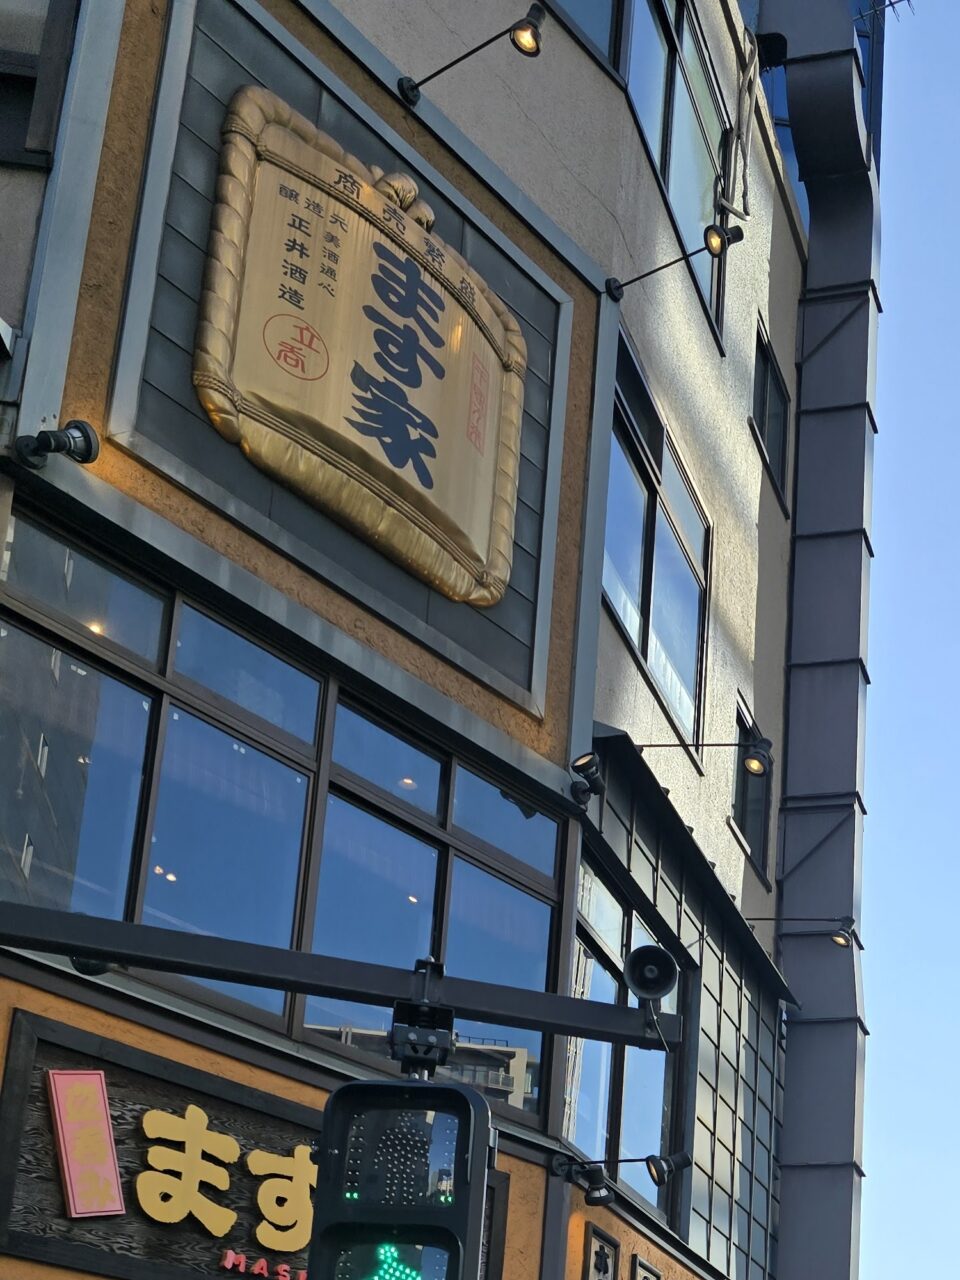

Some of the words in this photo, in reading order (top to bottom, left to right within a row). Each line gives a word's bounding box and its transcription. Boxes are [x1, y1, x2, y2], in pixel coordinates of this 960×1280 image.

[278, 213, 312, 310] 正井酒造
[343, 241, 446, 490] ます家
